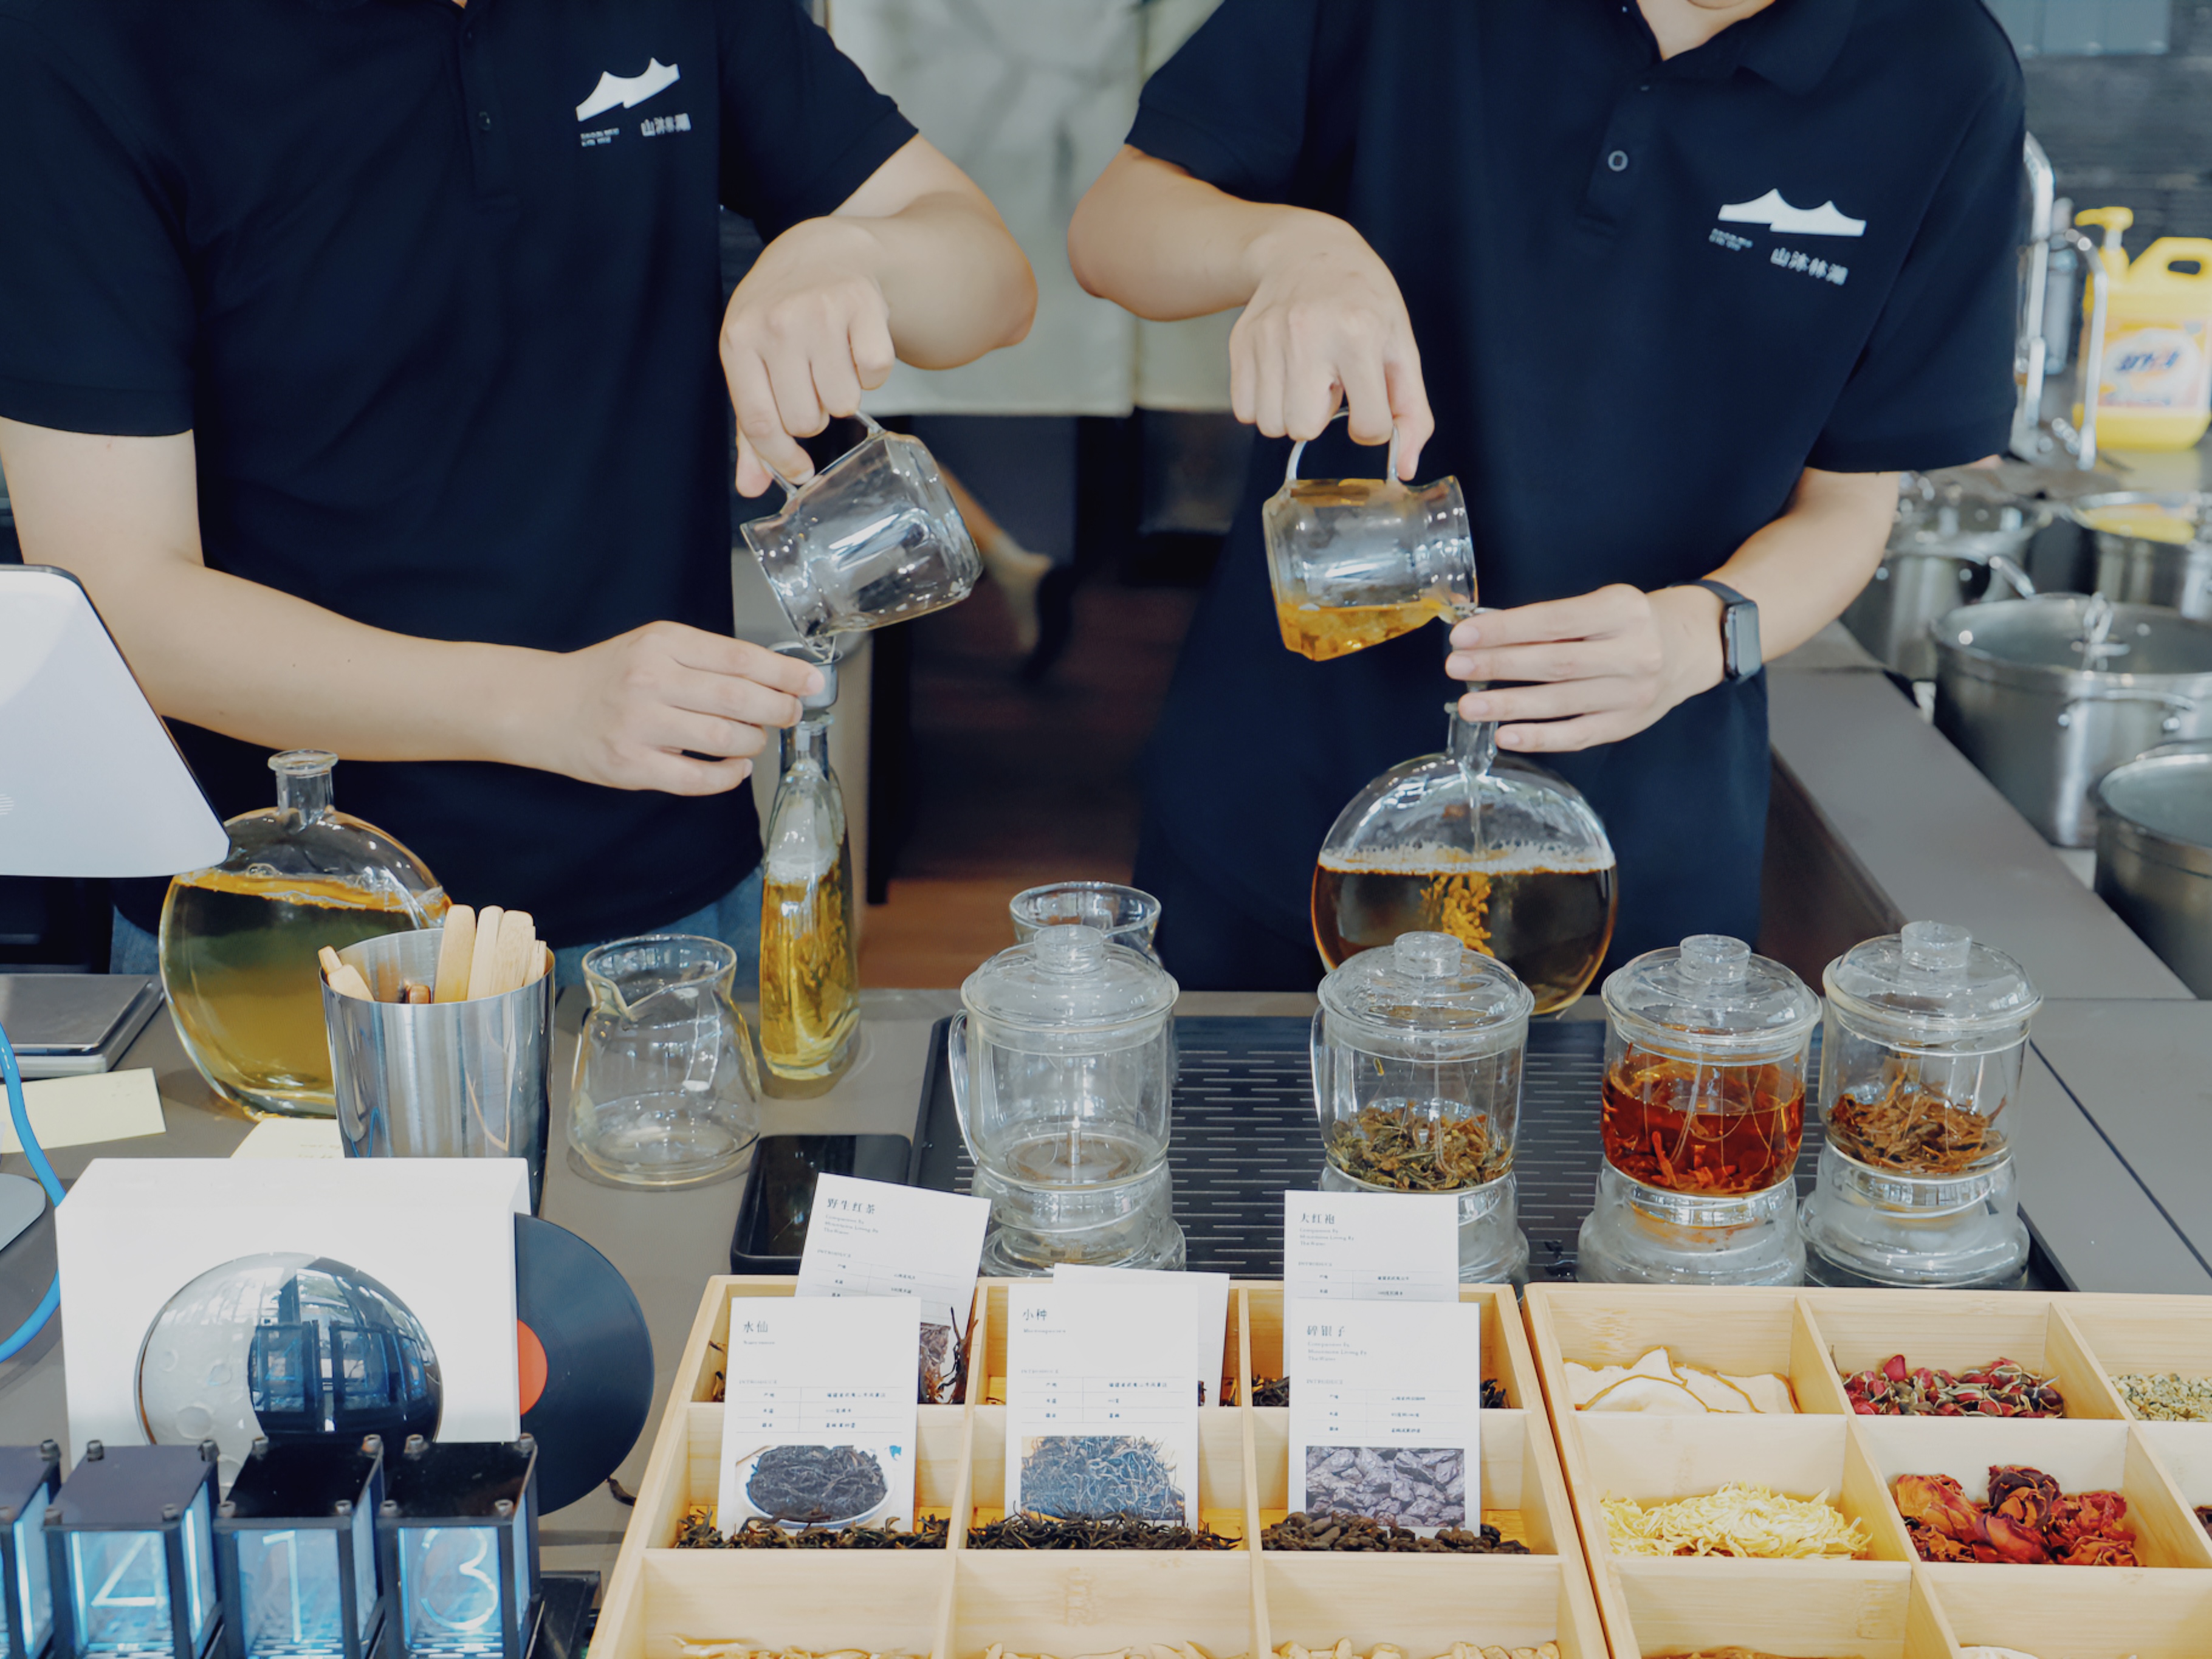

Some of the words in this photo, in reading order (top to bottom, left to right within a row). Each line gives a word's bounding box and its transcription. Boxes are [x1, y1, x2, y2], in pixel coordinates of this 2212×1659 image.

[827, 1198, 876, 1215] 野生红茶
[1300, 1212, 1335, 1224] 大红袍
[1022, 1308, 1048, 1321] 小种
[743, 1320, 769, 1333] 水仙
[1307, 1325, 1345, 1337] 碎银子
[91, 1531, 168, 1630] 4
[262, 1530, 301, 1643] 1
[421, 1527, 498, 1631] 3
